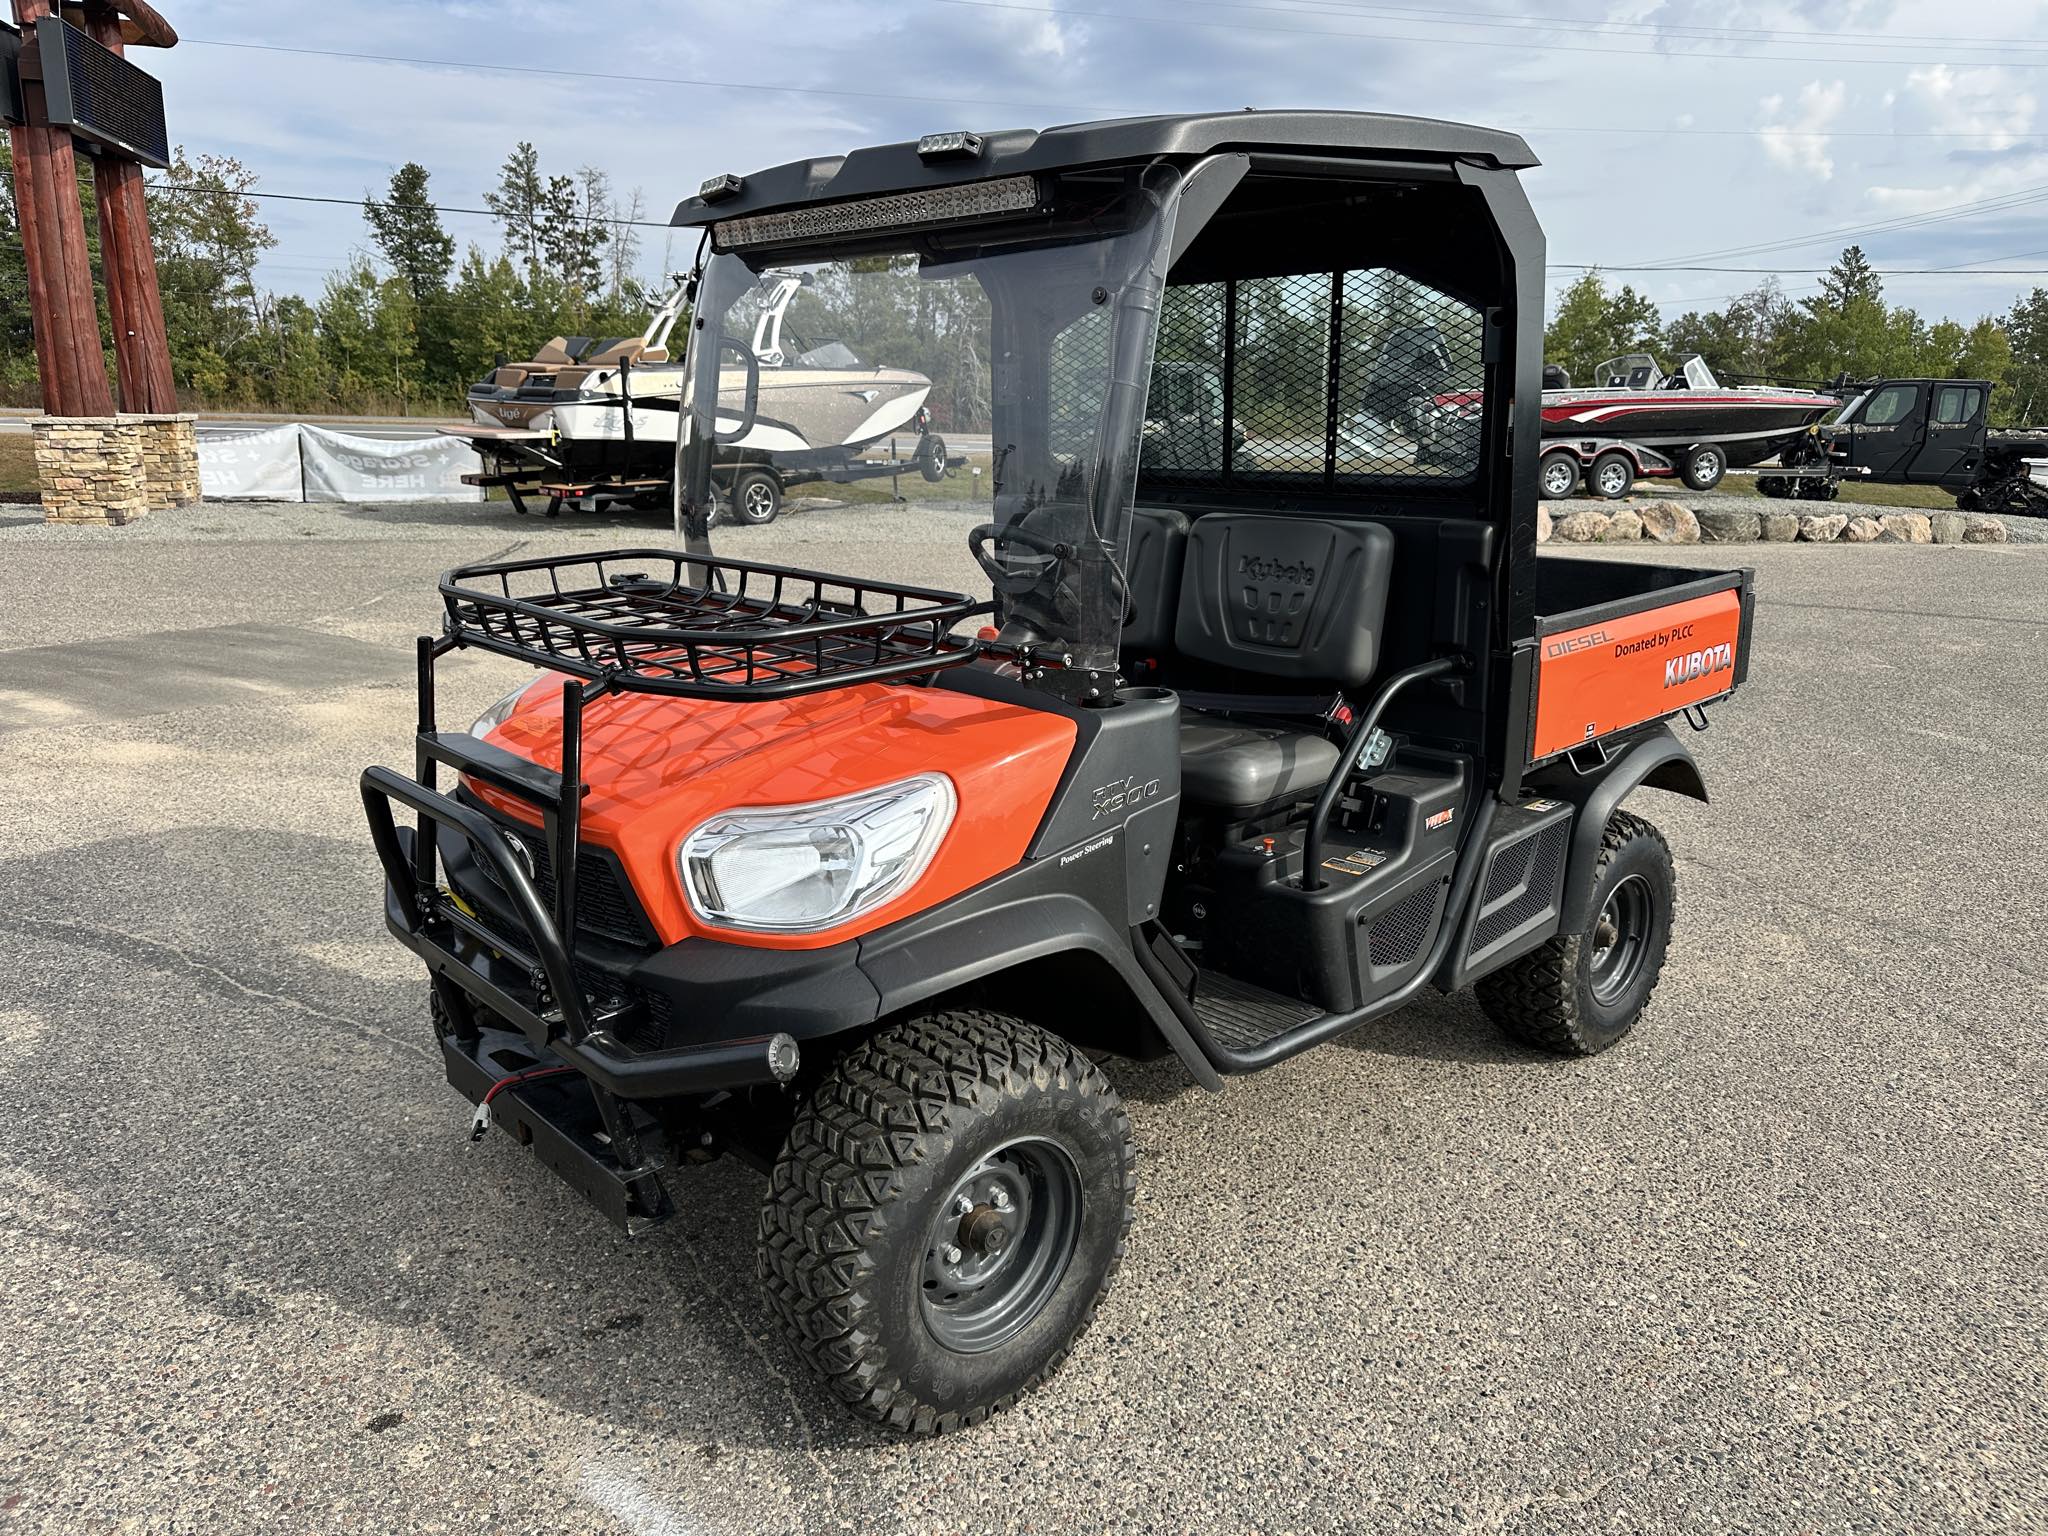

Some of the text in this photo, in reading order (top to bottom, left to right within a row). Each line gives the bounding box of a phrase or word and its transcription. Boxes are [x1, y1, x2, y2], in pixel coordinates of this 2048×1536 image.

[1239, 555, 1315, 586] Kubota
[1547, 630, 1615, 658] DIESEL
[1614, 624, 1694, 658] Donated by PLCC
[1664, 642, 1732, 688] KUBOTA
[1091, 778, 1160, 821] X900
[1060, 835, 1114, 866] Power Steering
